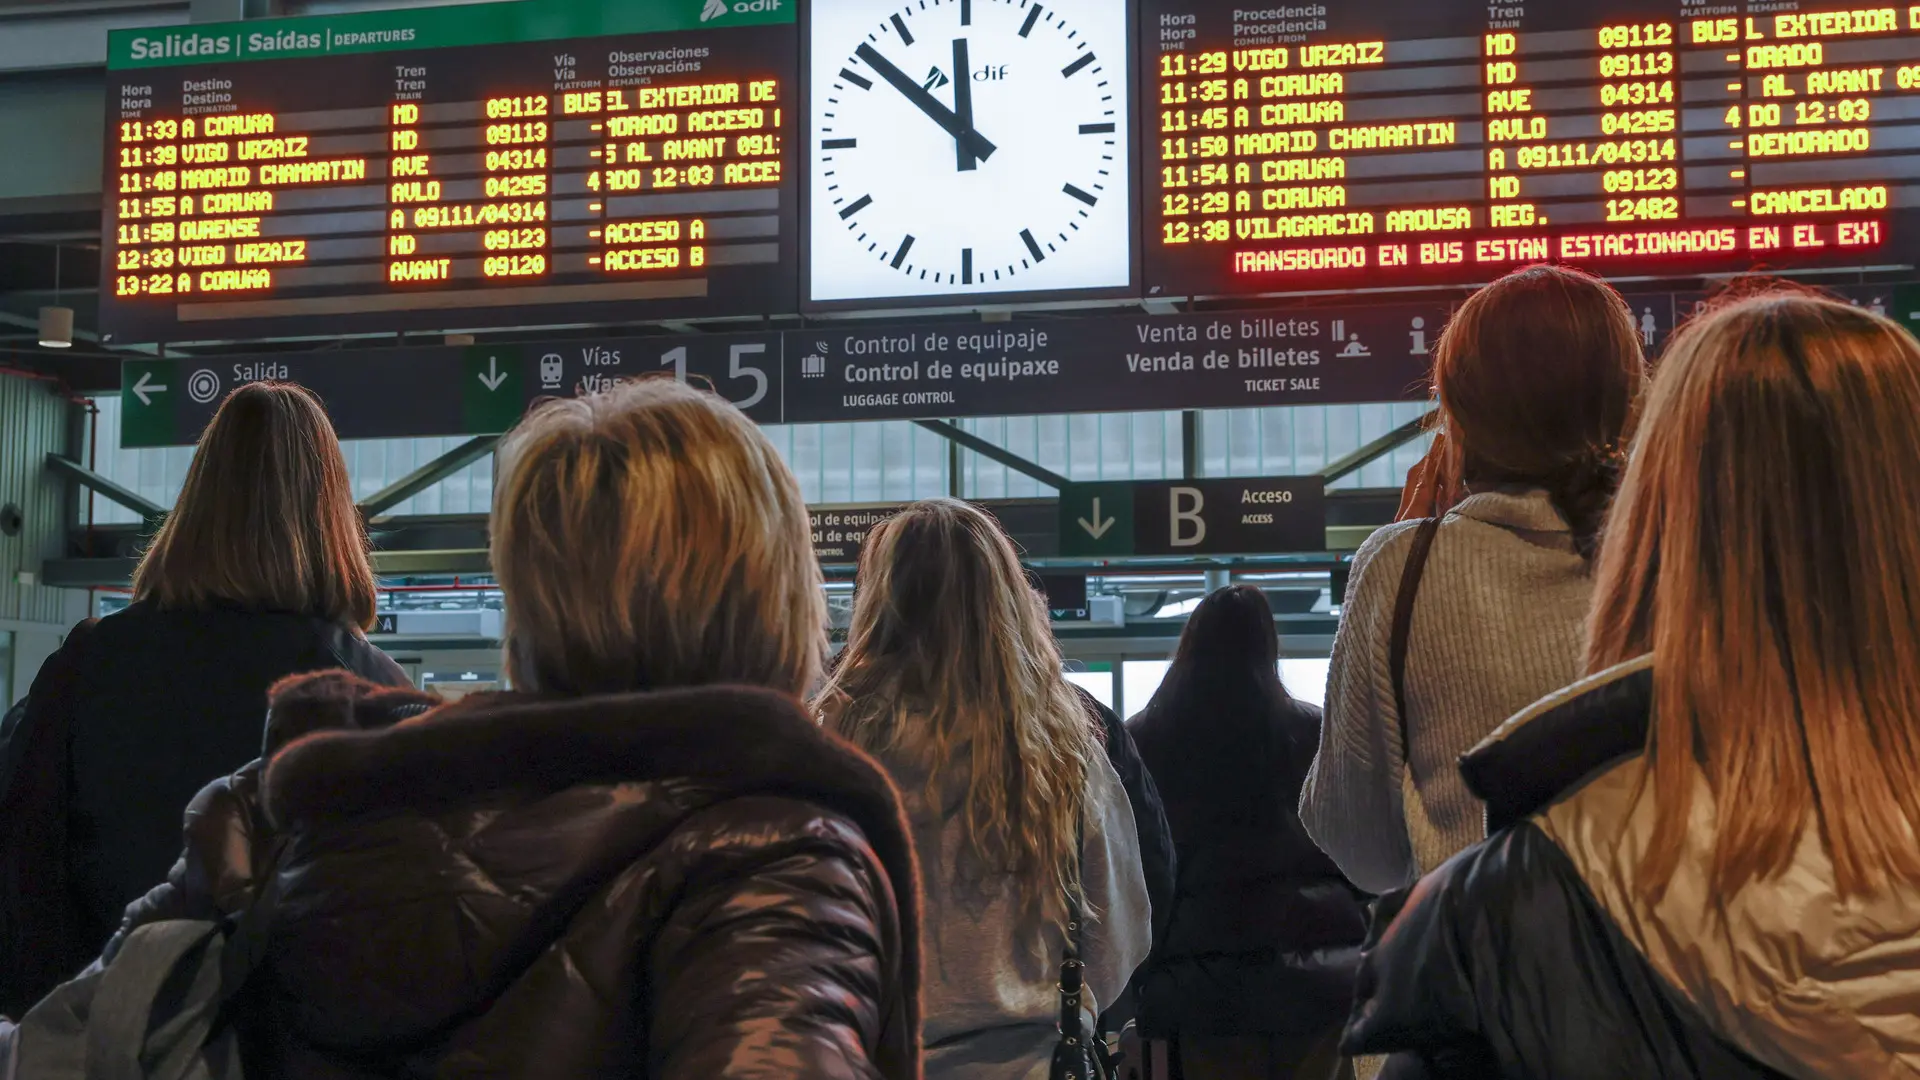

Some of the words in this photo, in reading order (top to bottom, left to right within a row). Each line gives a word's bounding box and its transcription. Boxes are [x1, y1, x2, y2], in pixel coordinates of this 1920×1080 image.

[1160, 14, 1196, 26] Hora
[1233, 4, 1326, 22] Procedencia
[1487, 6, 1524, 19] Tren
[1160, 28, 1197, 40] Hora
[1233, 18, 1327, 37] Procedencia
[131, 34, 230, 60] Salidas
[248, 28, 321, 52] Saídas
[334, 28, 416, 46] DEPARTURES
[1160, 50, 1227, 77] 11:29
[1232, 47, 1288, 72] VIGO
[1300, 41, 1384, 68] URZAIZ
[1485, 33, 1516, 56] MD
[1598, 22, 1672, 49] 09112
[1692, 18, 1738, 43] BUS
[1774, 8, 1898, 38] EXTERIOR
[1161, 42, 1185, 50] TIME
[1234, 36, 1273, 47] COMING
[1277, 34, 1306, 44] FROM
[554, 54, 576, 67] Vía
[608, 47, 709, 64] Observaciones
[396, 65, 426, 78] Tren
[554, 68, 576, 81] Vía
[608, 61, 701, 78] Observacións
[1161, 78, 1228, 105] 11:35
[1233, 78, 1248, 100] A
[1260, 72, 1343, 98] CORUÑA
[1486, 61, 1517, 85] MD
[1599, 51, 1673, 78] 09113
[121, 84, 152, 97] Hora
[183, 78, 232, 93] Destino
[395, 78, 426, 91] Tren
[554, 80, 601, 91] PLATFORM
[608, 77, 652, 87] REMARKS
[121, 97, 152, 110] Hora
[183, 92, 231, 107] Destino
[1161, 107, 1228, 133] 11:45
[1234, 106, 1249, 128] A
[1260, 100, 1344, 126] CORUÑA
[1487, 89, 1532, 113] AVE
[1600, 80, 1674, 107] 04314
[1762, 73, 1796, 97] AL
[1806, 68, 1883, 95] AVANT
[121, 119, 178, 143] 11:33
[181, 118, 195, 138] A
[204, 113, 274, 137] CORUÑA
[393, 104, 418, 125] MD
[486, 95, 548, 119] 09112
[563, 91, 602, 114] BUS
[639, 82, 739, 109] EXTERIOR
[749, 80, 776, 102] DE
[121, 110, 142, 119] TIME
[183, 104, 237, 115] DESTINATION
[1161, 135, 1228, 161] 11:50
[1234, 130, 1317, 156] MADRID
[1328, 122, 1455, 150] CHAMARTIN
[1488, 117, 1547, 142] AVLO
[1601, 109, 1675, 135] 04295
[1724, 105, 1741, 128] 4
[1794, 98, 1870, 126] 12:03
[120, 145, 177, 169] 11:39
[181, 142, 229, 164] VIGO
[237, 136, 308, 161] URZAIZ
[392, 130, 418, 151] MD
[486, 121, 547, 145] 09113
[687, 108, 764, 133] ACCESO
[119, 170, 177, 194] 11:48
[180, 166, 251, 190] MADRID
[259, 159, 365, 185] CHAMARTIN
[392, 155, 429, 177] AVE
[485, 148, 547, 171] 04314
[626, 141, 653, 163] AL
[663, 137, 726, 161] AVANT
[1162, 163, 1229, 189] 11:54
[1234, 162, 1250, 184] A
[1261, 156, 1345, 182] CORUÑA
[1489, 148, 1505, 170] A
[1517, 138, 1676, 169] 09111/04314
[1748, 128, 1869, 157] DEMORADO
[118, 196, 176, 219] 11:55
[180, 195, 194, 216] A
[202, 191, 273, 214] CORUÑA
[391, 180, 441, 203] AVLO
[485, 174, 546, 198] 04295
[586, 171, 601, 192] 4
[652, 164, 714, 190] 12:03
[1162, 191, 1229, 217] 12:29
[1235, 190, 1250, 212] A
[1262, 185, 1346, 210] CORUÑA
[1489, 176, 1520, 199] MD
[1603, 167, 1677, 193] 09123
[179, 217, 261, 241] OURENSE
[390, 209, 405, 229] A
[414, 201, 546, 228] 09111/04314
[1163, 219, 1230, 245] 12:38
[1235, 212, 1374, 240] VILAGARCIA
[1385, 207, 1471, 233] AROUSA
[1490, 203, 1548, 227] REG.
[1606, 196, 1678, 222] 12482
[1750, 186, 1887, 215] CANCELADO
[117, 248, 174, 270] 12:33
[178, 245, 226, 267] VIGO
[234, 240, 305, 264] URZAIZ
[390, 234, 416, 255] MD
[484, 227, 546, 250] 09123
[605, 220, 680, 244] ACCESO
[690, 219, 704, 240] A
[1378, 244, 1407, 266] EN
[1420, 241, 1463, 264] BUS
[1476, 238, 1548, 262] ESTAN
[1561, 229, 1736, 258] ESTACIONADOS
[1749, 226, 1780, 249] EN
[1793, 224, 1824, 247] EL
[117, 273, 173, 296] 13:22
[177, 272, 191, 291] A
[199, 268, 271, 291] CORUÑA
[389, 259, 451, 282] AVANT
[483, 254, 545, 277] 09120
[604, 247, 680, 271] ACCESO
[690, 246, 704, 267] B
[1137, 322, 1197, 343] Venta
[1206, 320, 1232, 340] de
[1241, 318, 1320, 339] billetes
[844, 333, 916, 355] Control
[924, 333, 948, 352] de
[957, 328, 1048, 353] equipaje
[582, 346, 621, 366] Vías
[1126, 352, 1194, 373] Venda
[1202, 350, 1229, 369] de
[1238, 347, 1321, 368] billetes
[233, 361, 289, 382] Salida
[729, 343, 769, 409] 5
[844, 361, 919, 383] Control
[927, 358, 952, 379] de
[960, 357, 1059, 382] equipaxe
[1245, 378, 1286, 392] TICKET
[1290, 377, 1320, 390] SALE
[843, 392, 899, 407] LUGGAGE
[902, 391, 955, 405] CONTROL
[1241, 489, 1292, 504] Acceso
[825, 513, 840, 526] de
[1169, 486, 1206, 547] B
[1241, 513, 1273, 524] ACCESS
[827, 530, 842, 542] de
[383, 617, 393, 631] A
